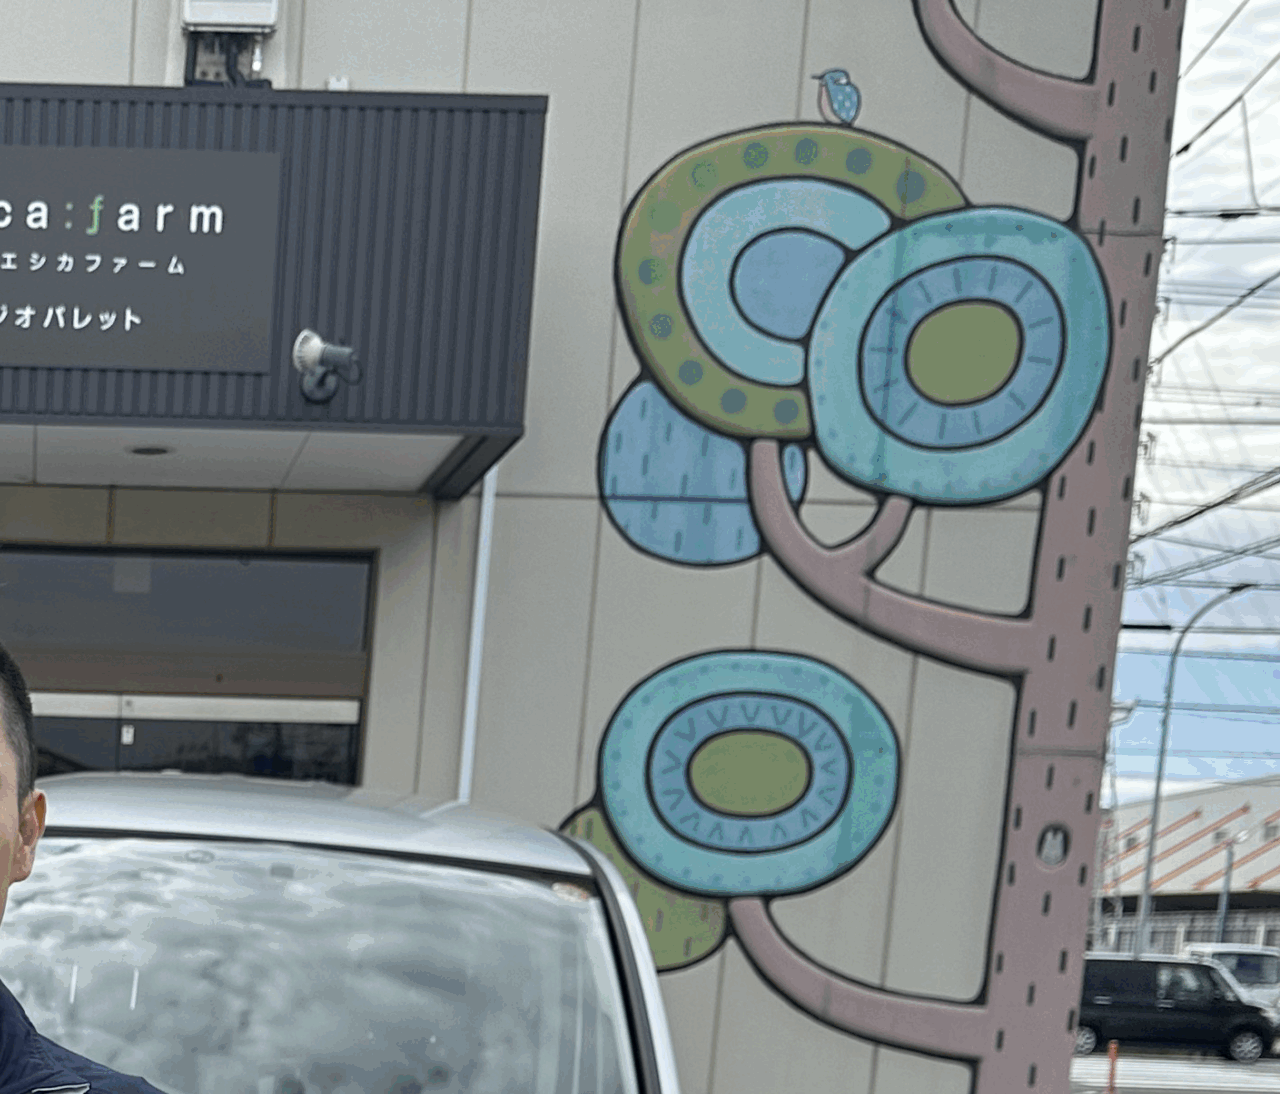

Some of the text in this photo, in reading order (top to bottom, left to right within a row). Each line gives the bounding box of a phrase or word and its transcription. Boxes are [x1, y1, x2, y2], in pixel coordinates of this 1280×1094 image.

[0, 251, 186, 275] エシカファーム
